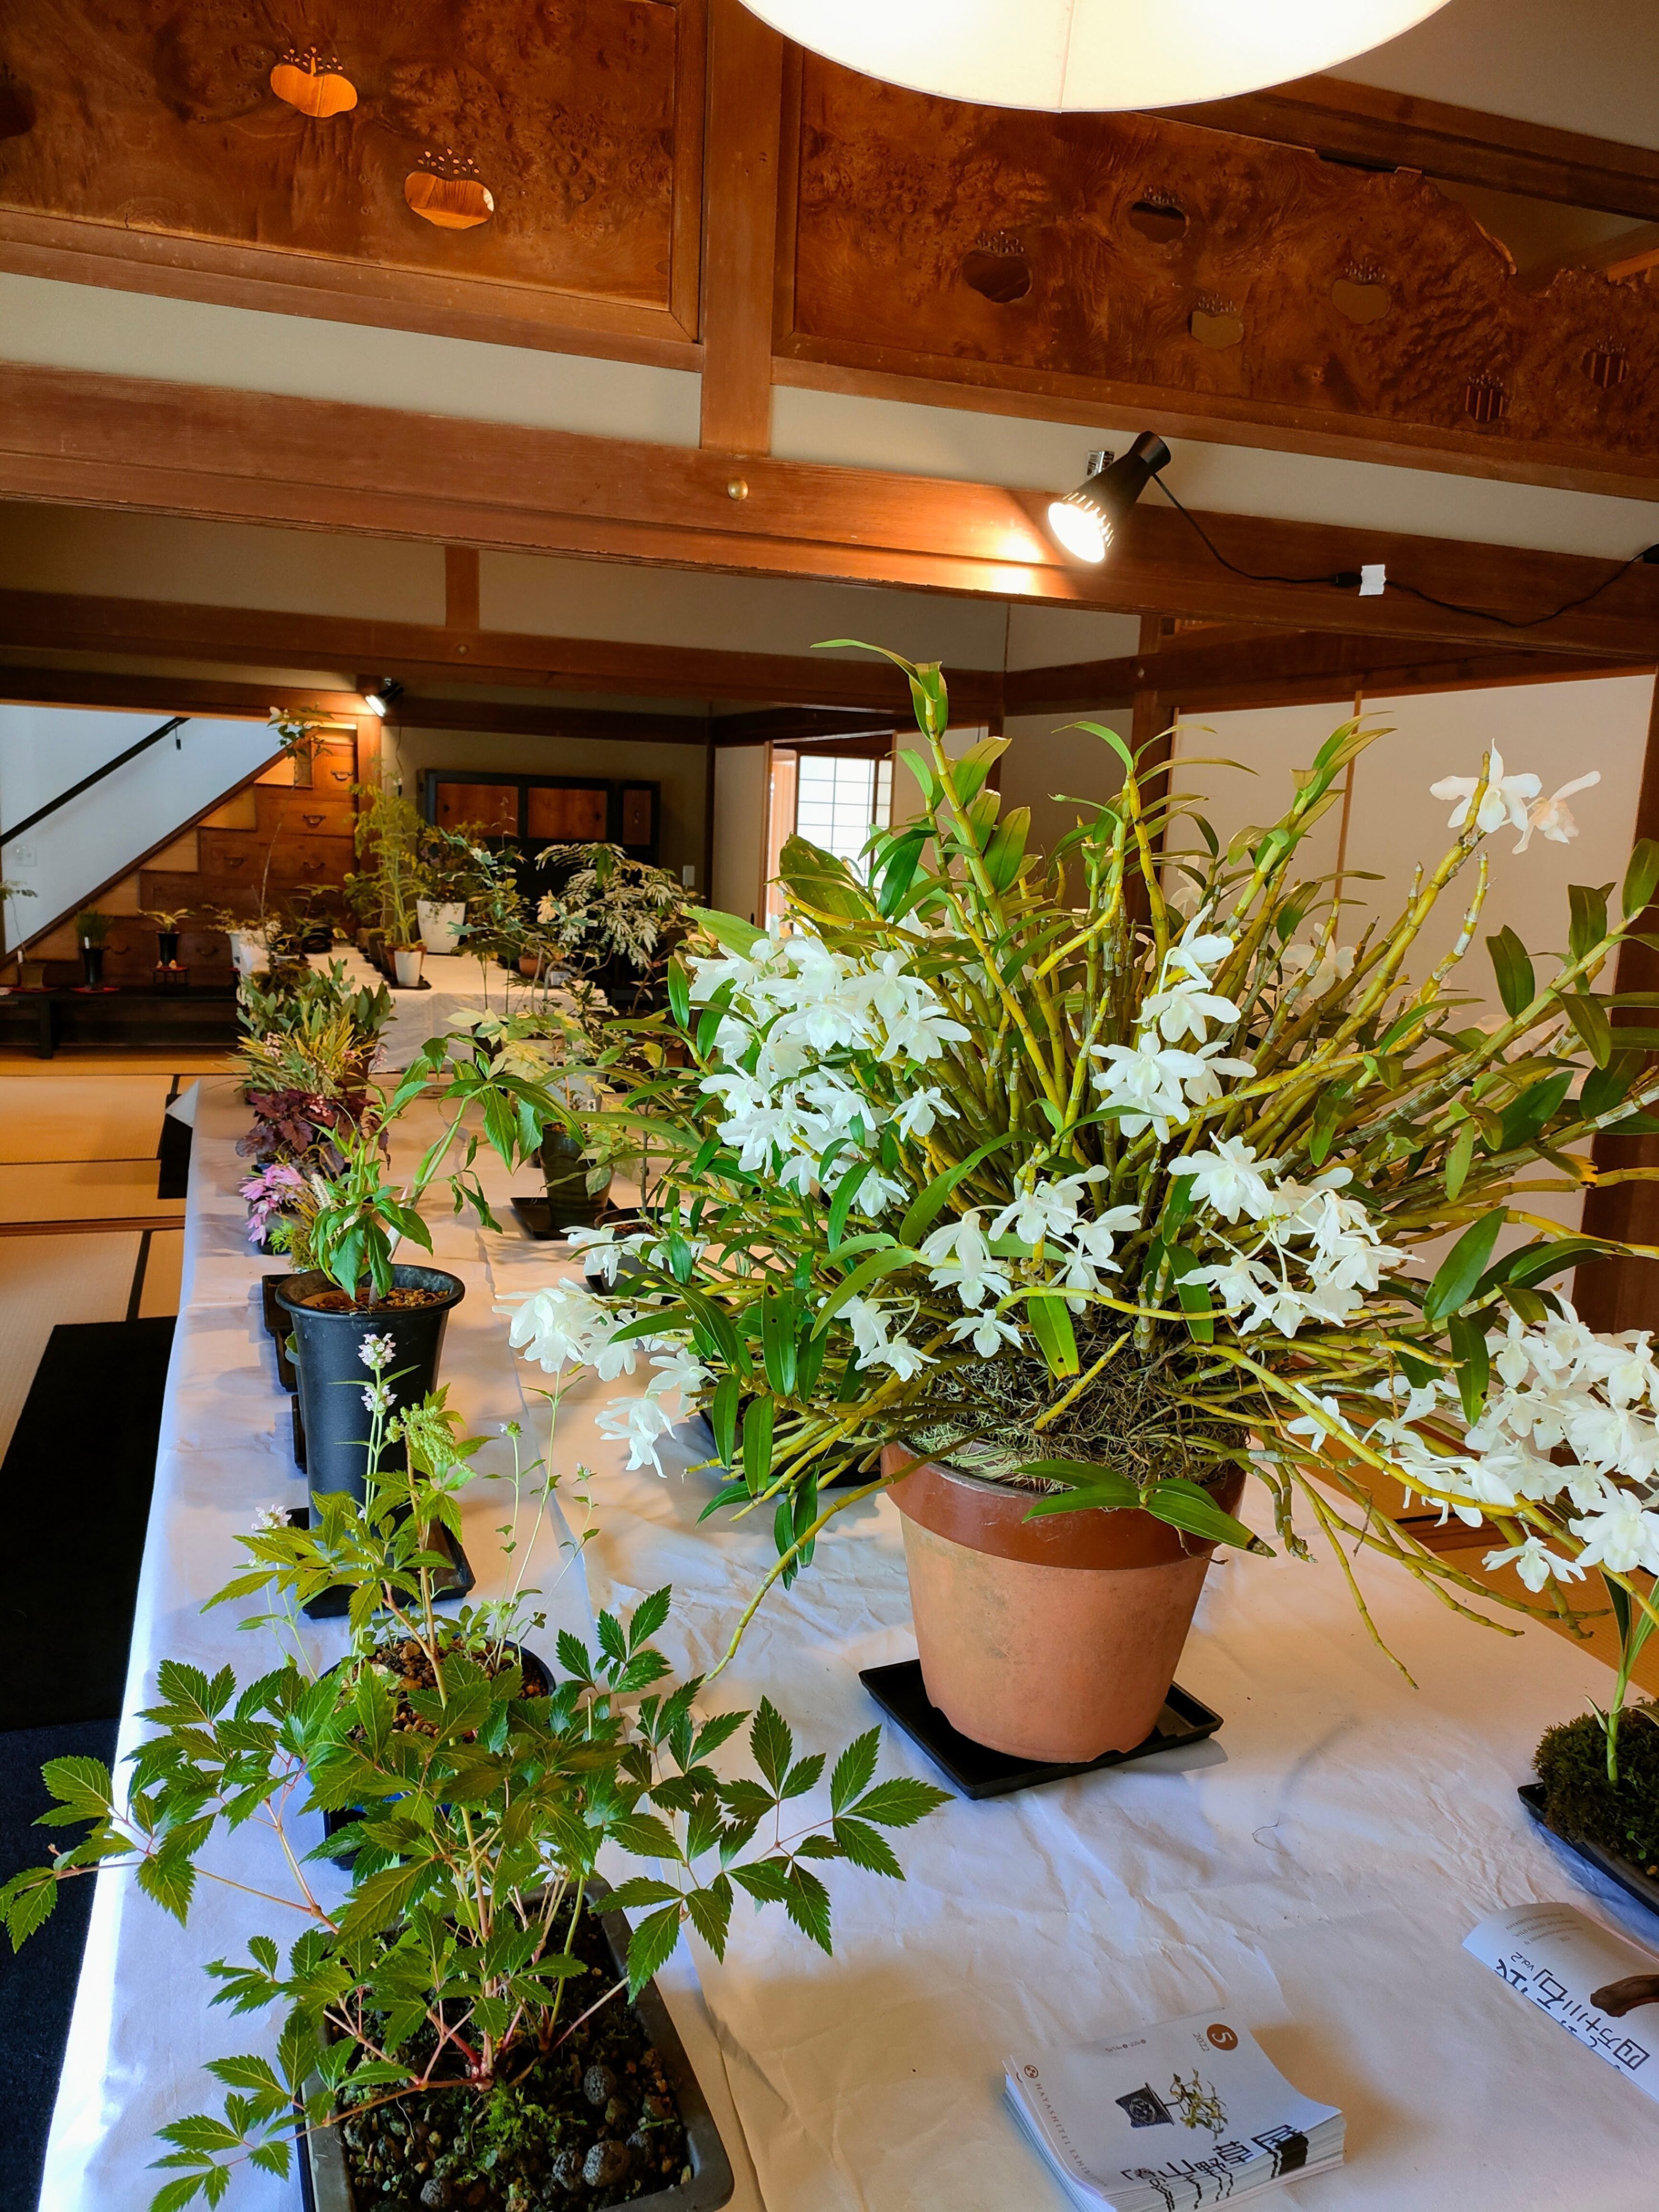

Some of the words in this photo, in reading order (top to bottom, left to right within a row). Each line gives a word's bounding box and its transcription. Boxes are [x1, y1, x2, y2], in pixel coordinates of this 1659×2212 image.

[1511, 1952, 1535, 1971] Vol.2
[1193, 2032, 1210, 2052] 2022
[1212, 2031, 1233, 2043] 5
[1035, 2083, 1071, 2145] HAYASHITEI
